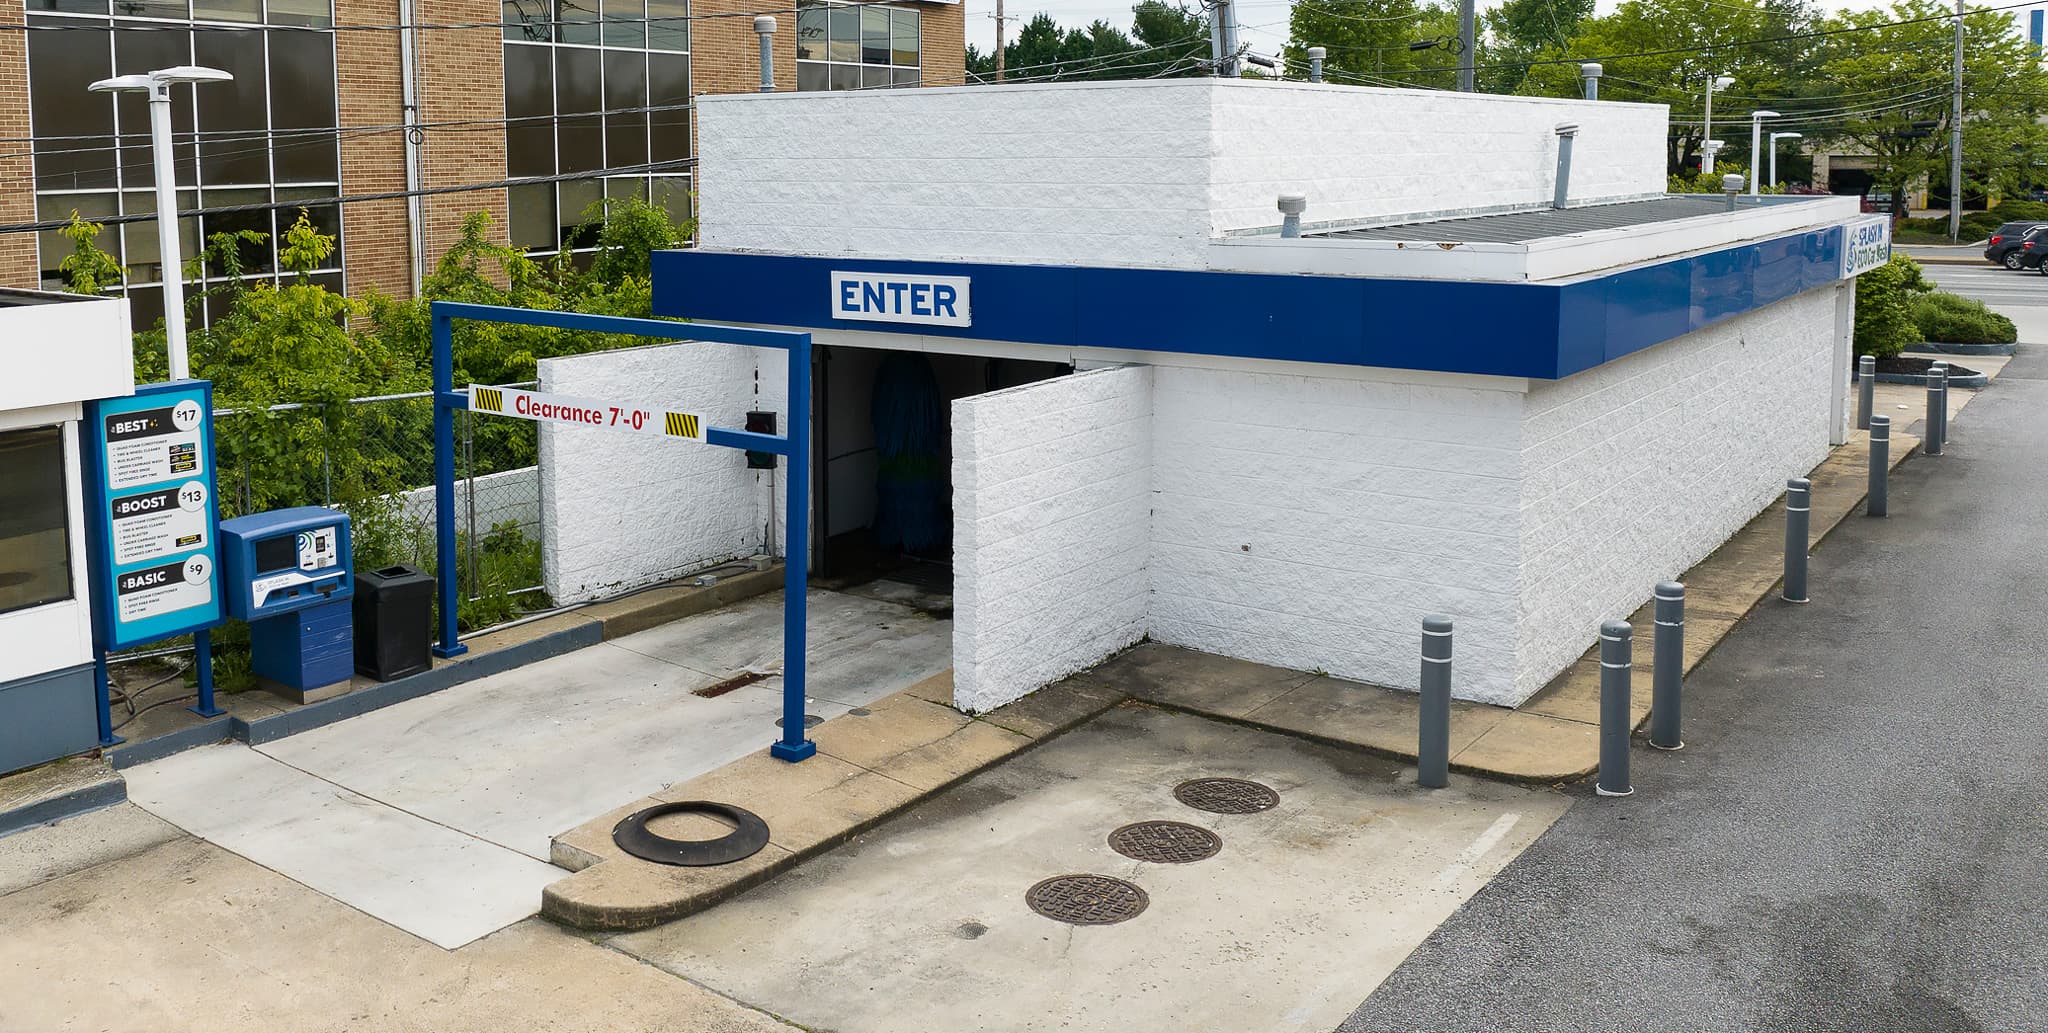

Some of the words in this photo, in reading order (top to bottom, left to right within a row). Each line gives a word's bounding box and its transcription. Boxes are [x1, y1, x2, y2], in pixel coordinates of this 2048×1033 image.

[1859, 224, 1877, 246] SPLASH
[1878, 224, 1882, 241] IN
[1876, 243, 1887, 262] Wash
[841, 280, 957, 317] ENTER
[176, 410, 196, 421] $17
[516, 394, 602, 424] Clearance
[609, 407, 650, 430] 7'-0"
[116, 419, 148, 434] BEST
[122, 496, 166, 513] BOOST
[182, 491, 201, 502] $13
[190, 564, 203, 575] $9
[127, 571, 166, 589] BASIC
